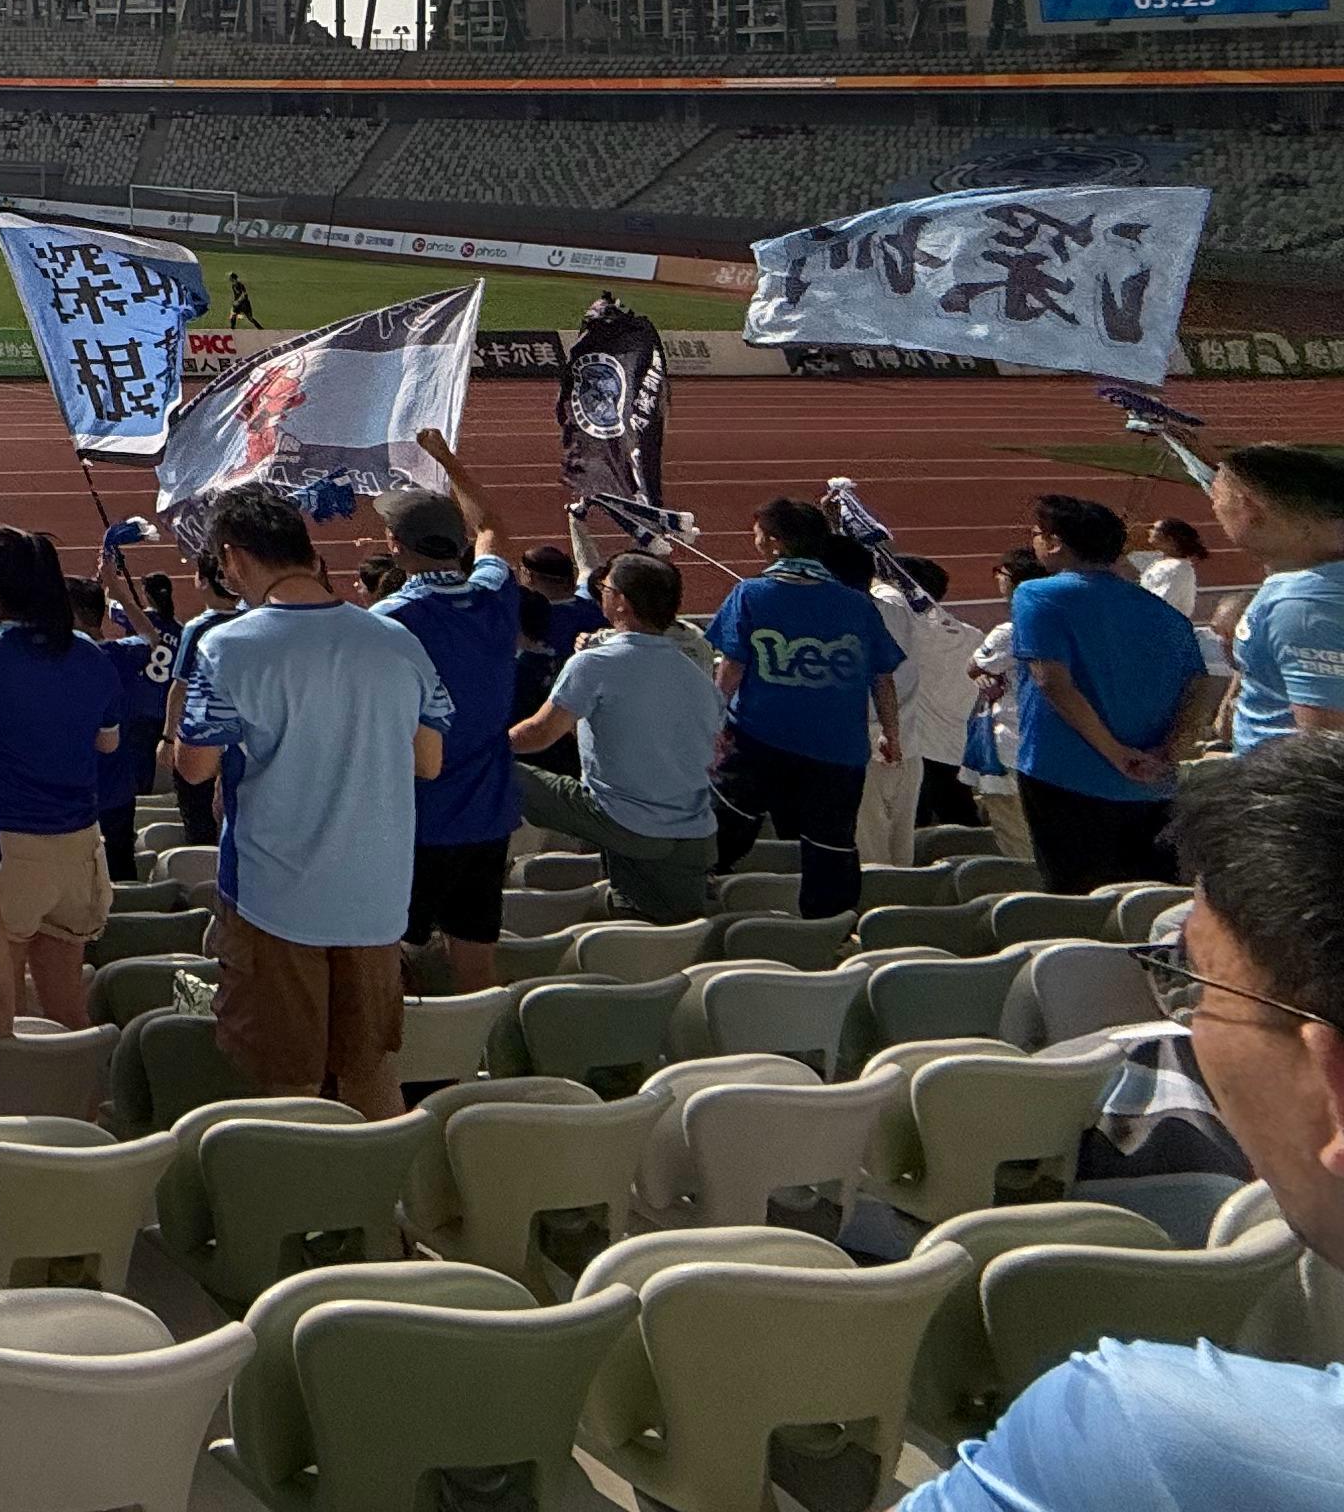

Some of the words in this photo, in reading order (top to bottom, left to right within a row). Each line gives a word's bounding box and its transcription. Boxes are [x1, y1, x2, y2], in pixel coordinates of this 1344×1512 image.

[189, 335, 237, 354] PICC
[486, 342, 560, 367] 卡尔美
[756, 637, 858, 681] Lee
